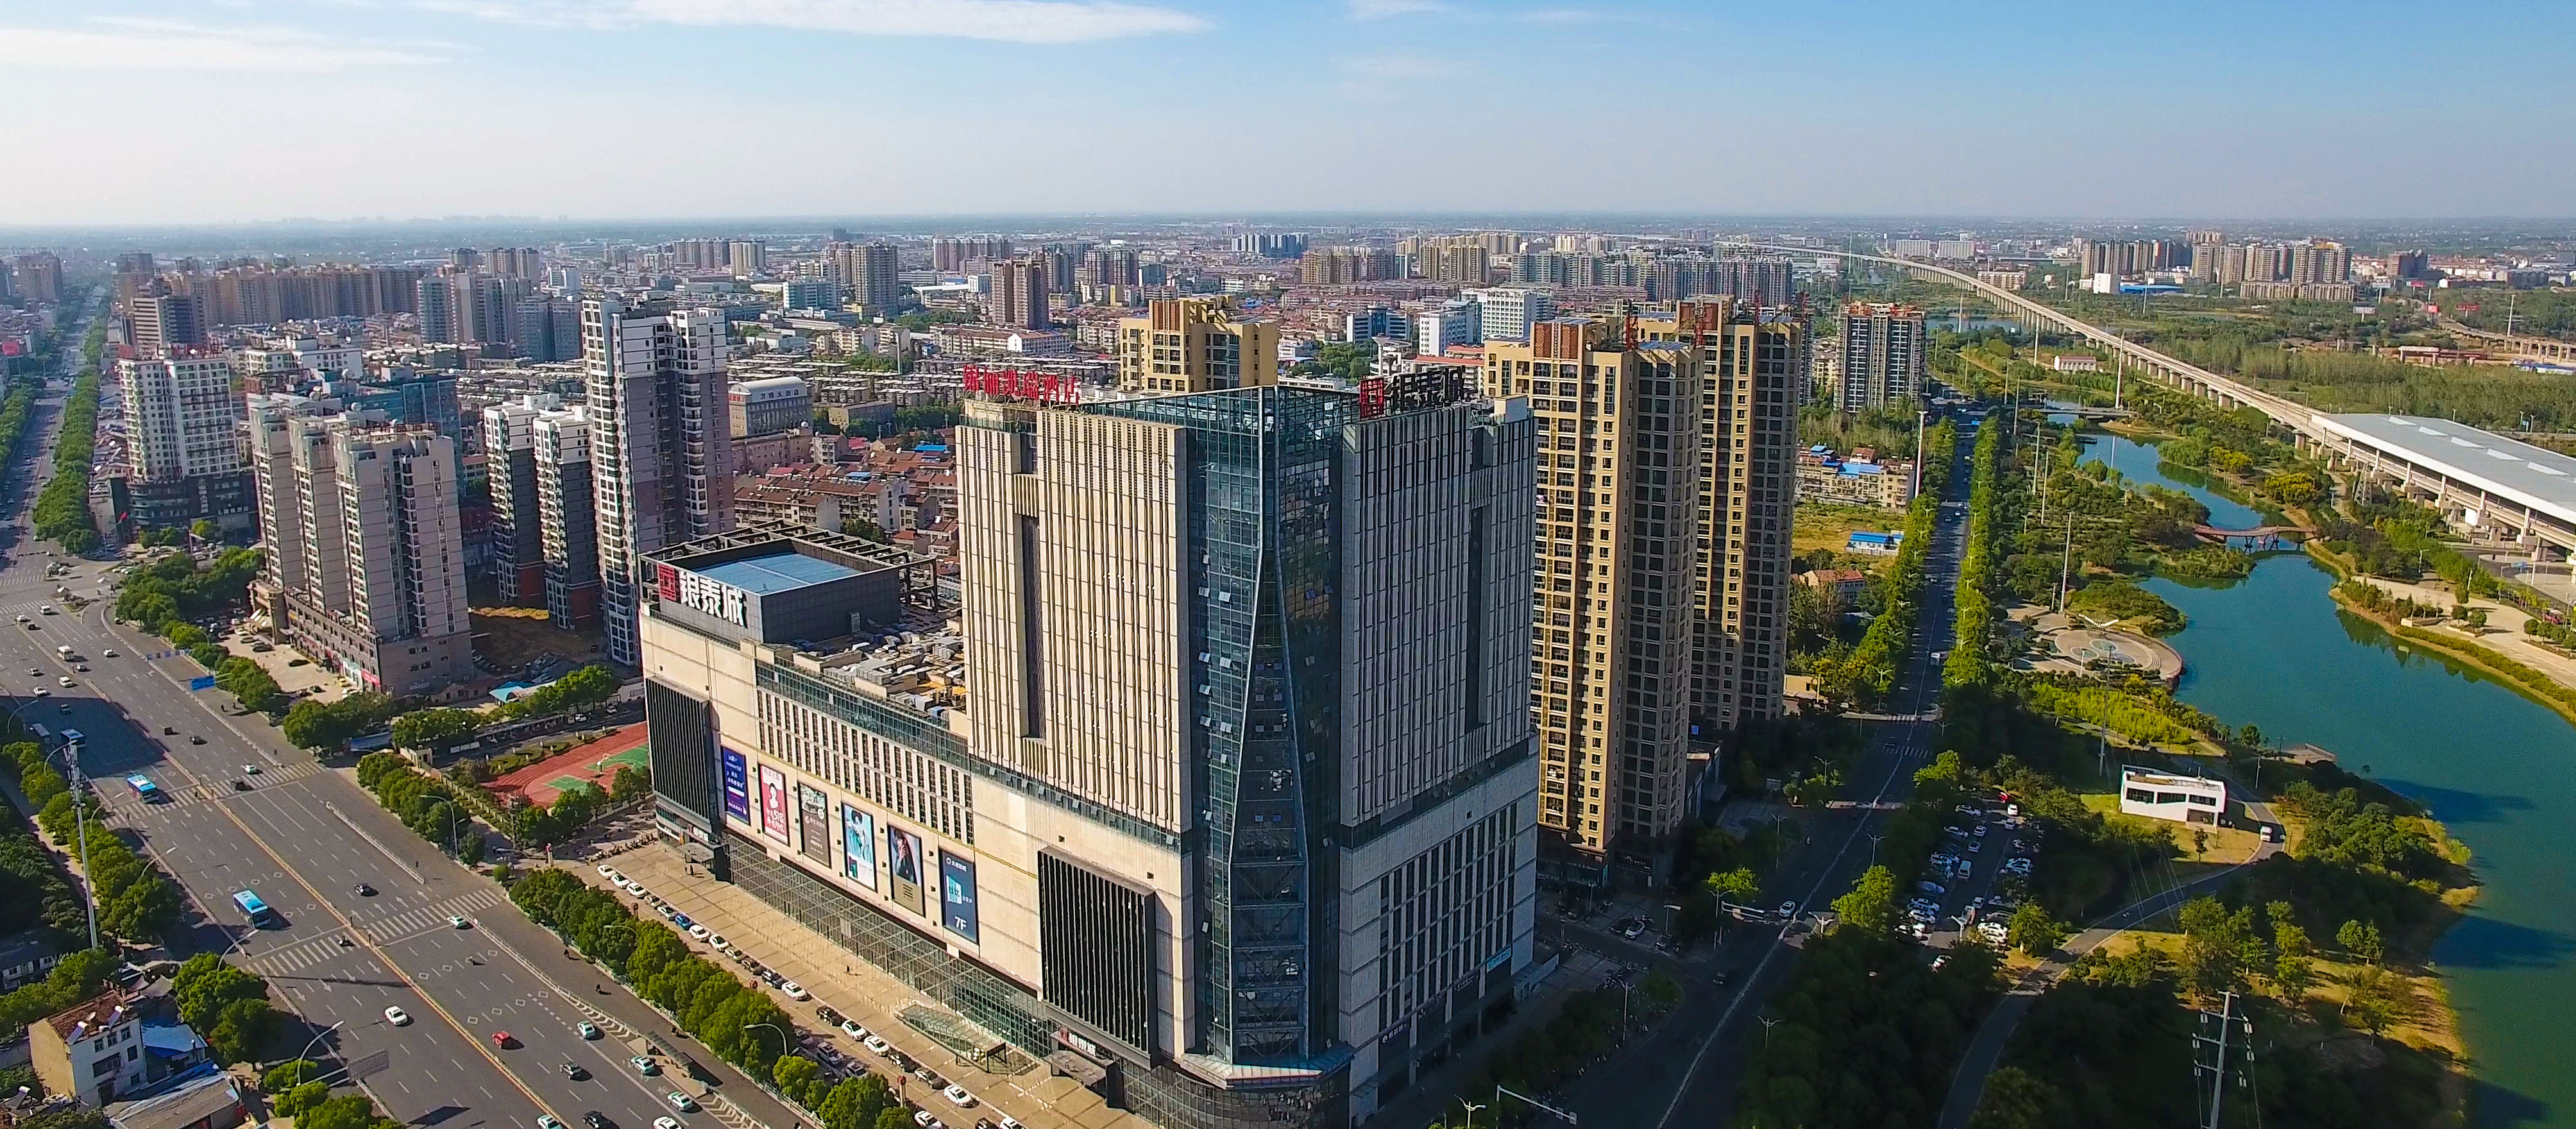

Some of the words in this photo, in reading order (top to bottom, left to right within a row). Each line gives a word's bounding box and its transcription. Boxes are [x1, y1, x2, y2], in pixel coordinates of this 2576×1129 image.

[680, 570, 747, 627] 银泰城
[954, 915, 967, 930] 7F
